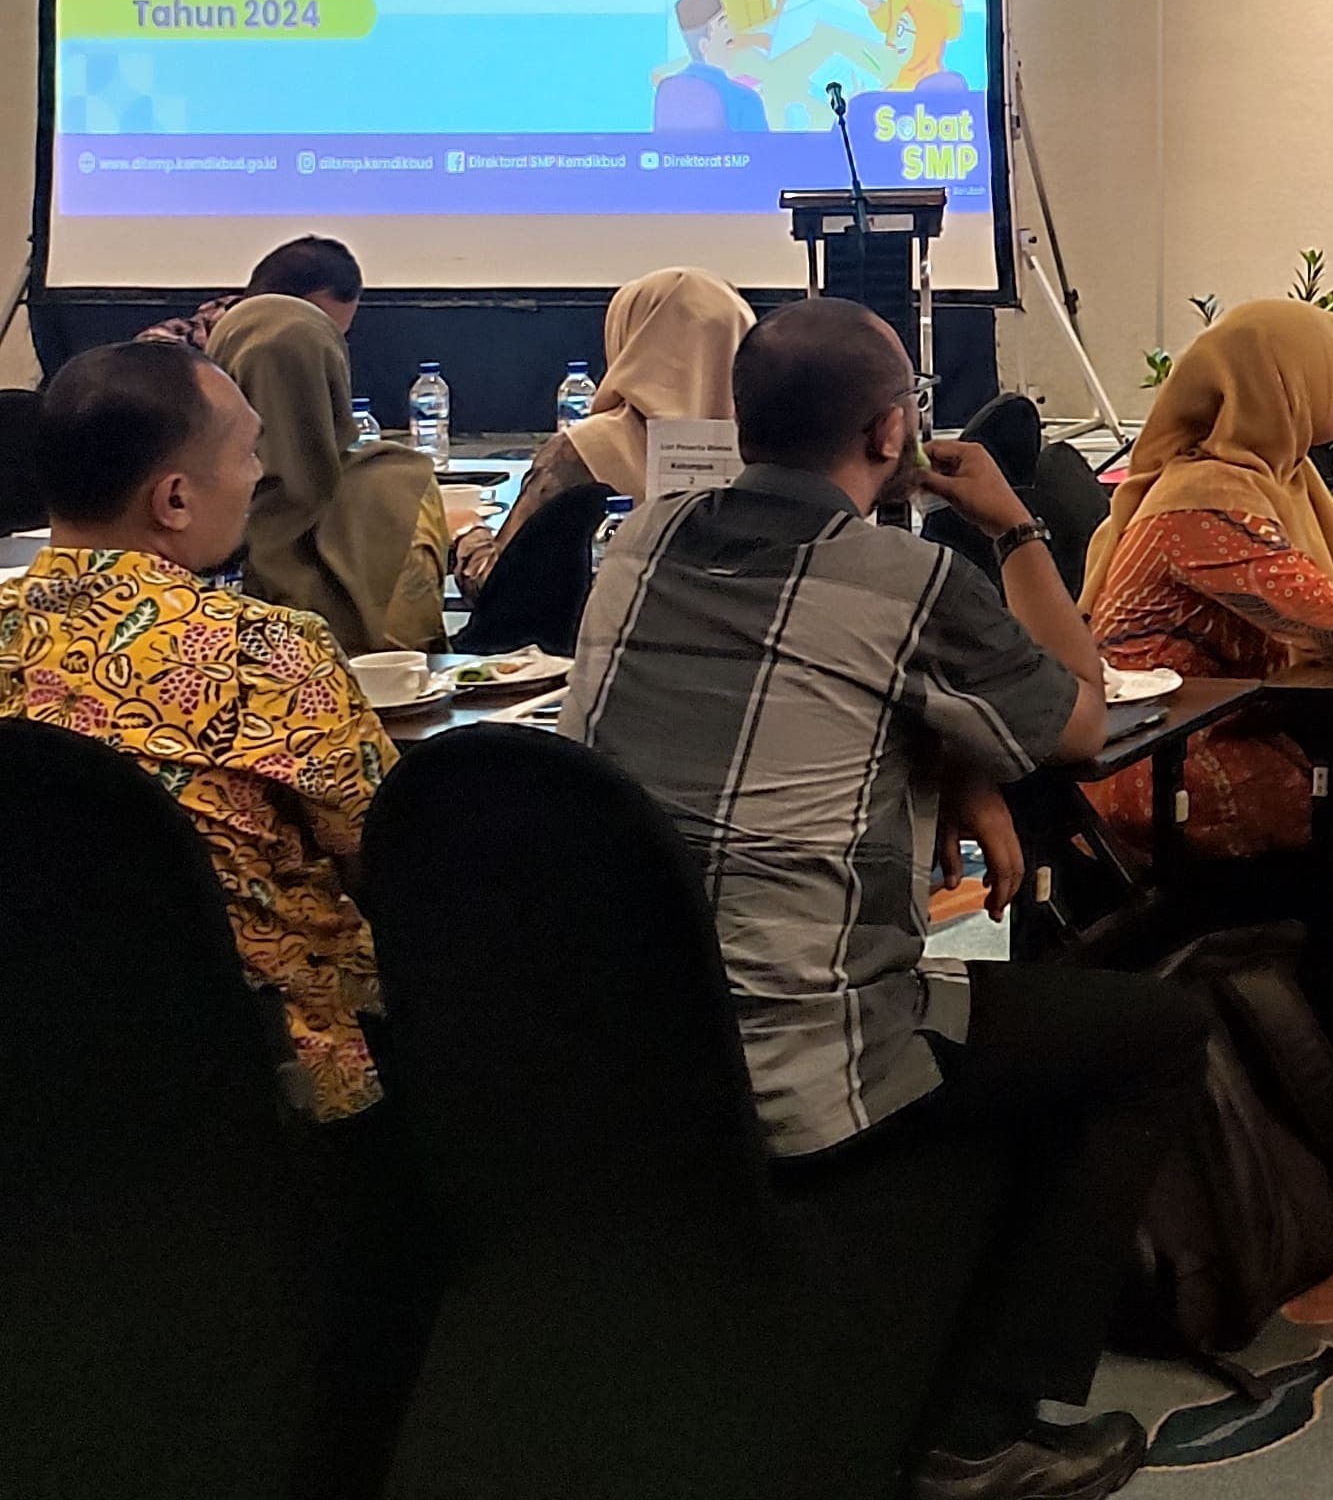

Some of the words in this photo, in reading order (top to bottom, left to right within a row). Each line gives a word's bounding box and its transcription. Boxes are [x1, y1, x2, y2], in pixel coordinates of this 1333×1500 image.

[132, 0, 237, 29] Tahun
[243, 0, 321, 29] 2024
[874, 103, 975, 142] Sobat
[468, 155, 528, 169] Direktorat
[530, 156, 556, 169] SMP
[663, 155, 723, 169] Direktorat
[724, 155, 751, 168] SMP
[902, 144, 979, 180] SMP
